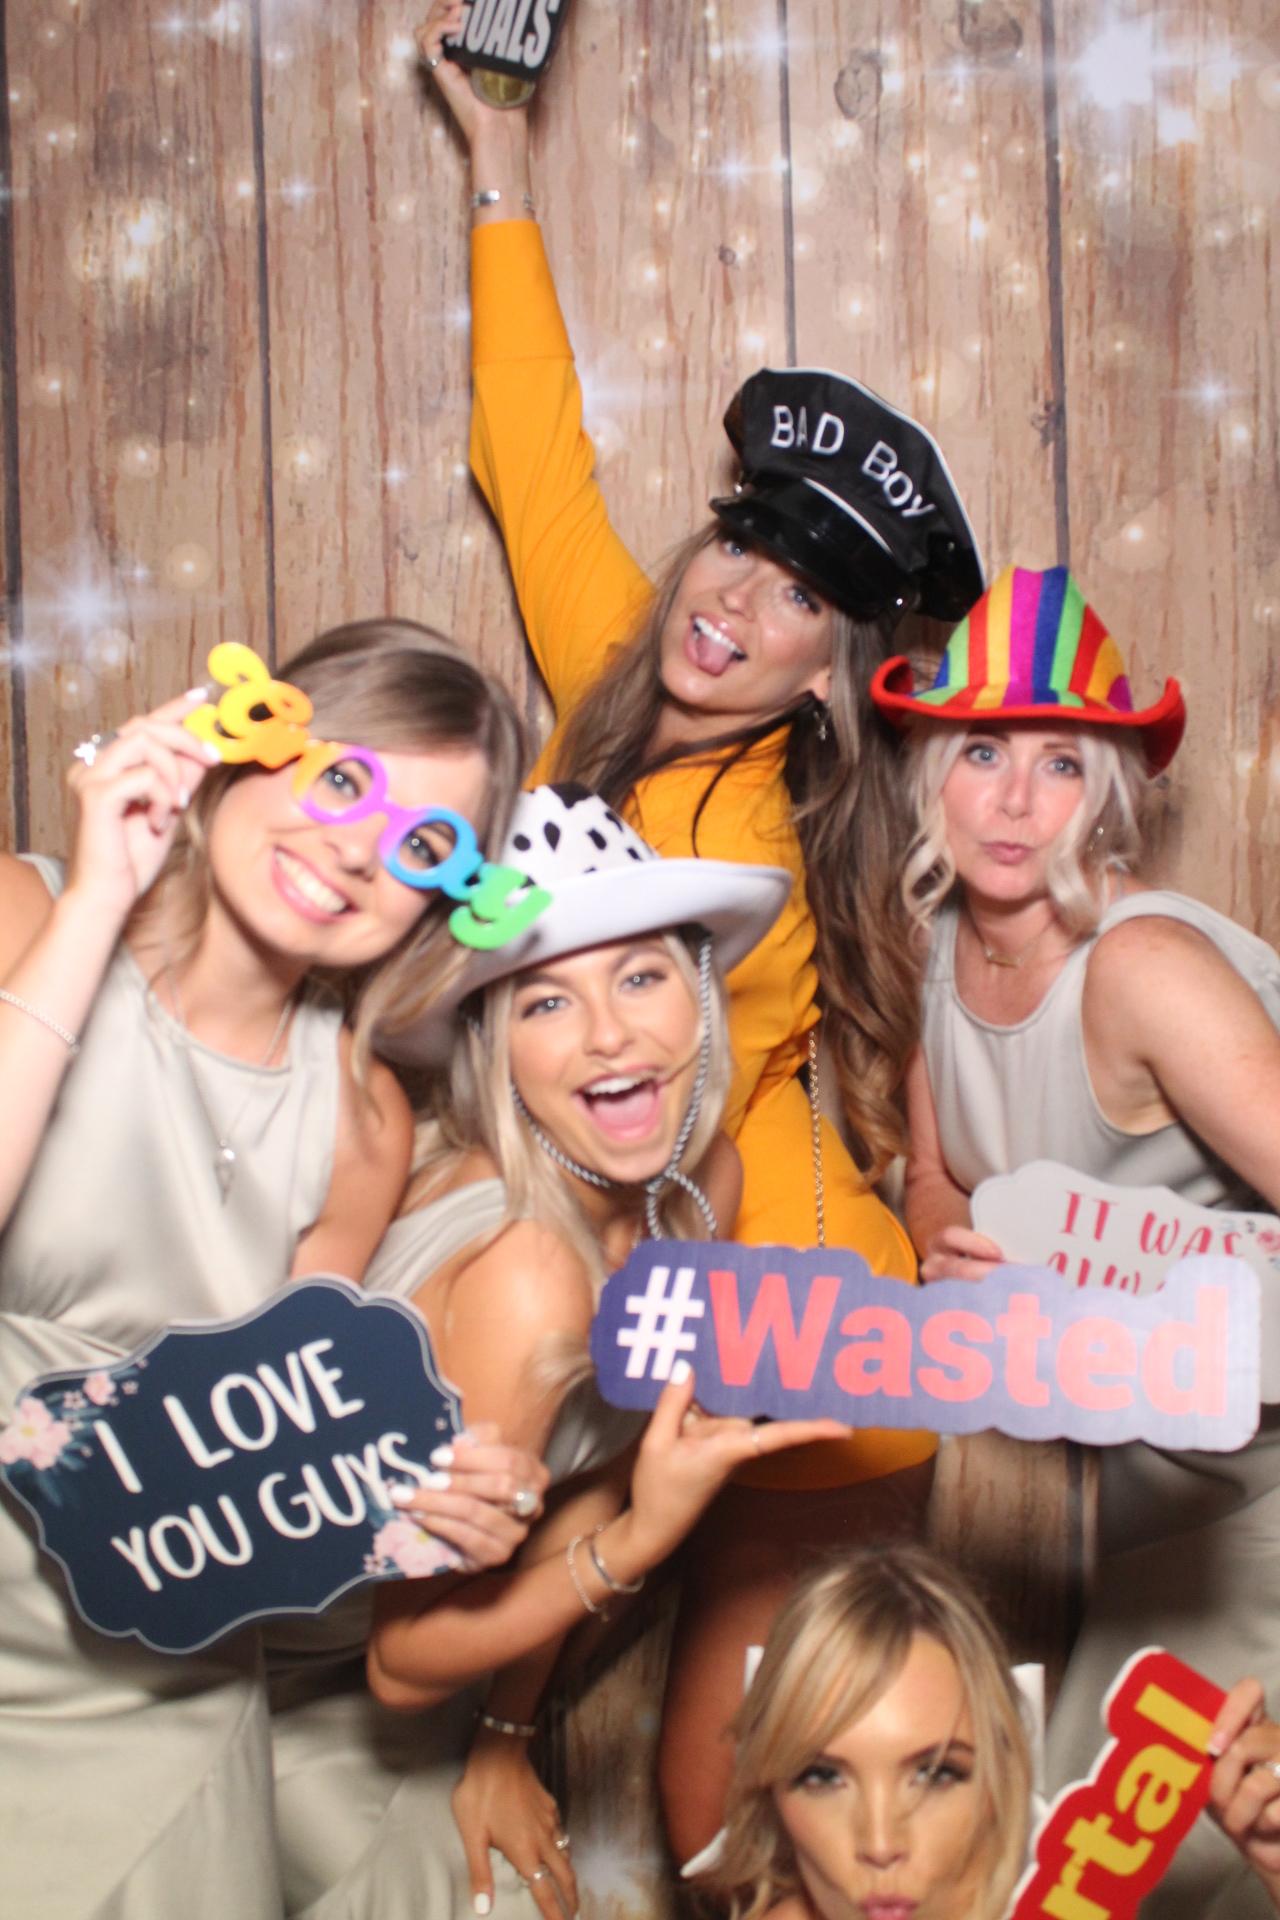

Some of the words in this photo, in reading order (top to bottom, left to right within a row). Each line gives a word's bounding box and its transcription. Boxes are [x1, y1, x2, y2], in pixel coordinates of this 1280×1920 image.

[770, 405, 845, 455] BAD
[861, 440, 936, 518] BOY
[1059, 1189, 1117, 1243] IT
[94, 1419, 143, 1494] I
[163, 1338, 365, 1468] LOVE
[616, 1266, 1230, 1417] #Wasted
[111, 1494, 254, 1592] YOU
[257, 1431, 434, 1539] GUYS
